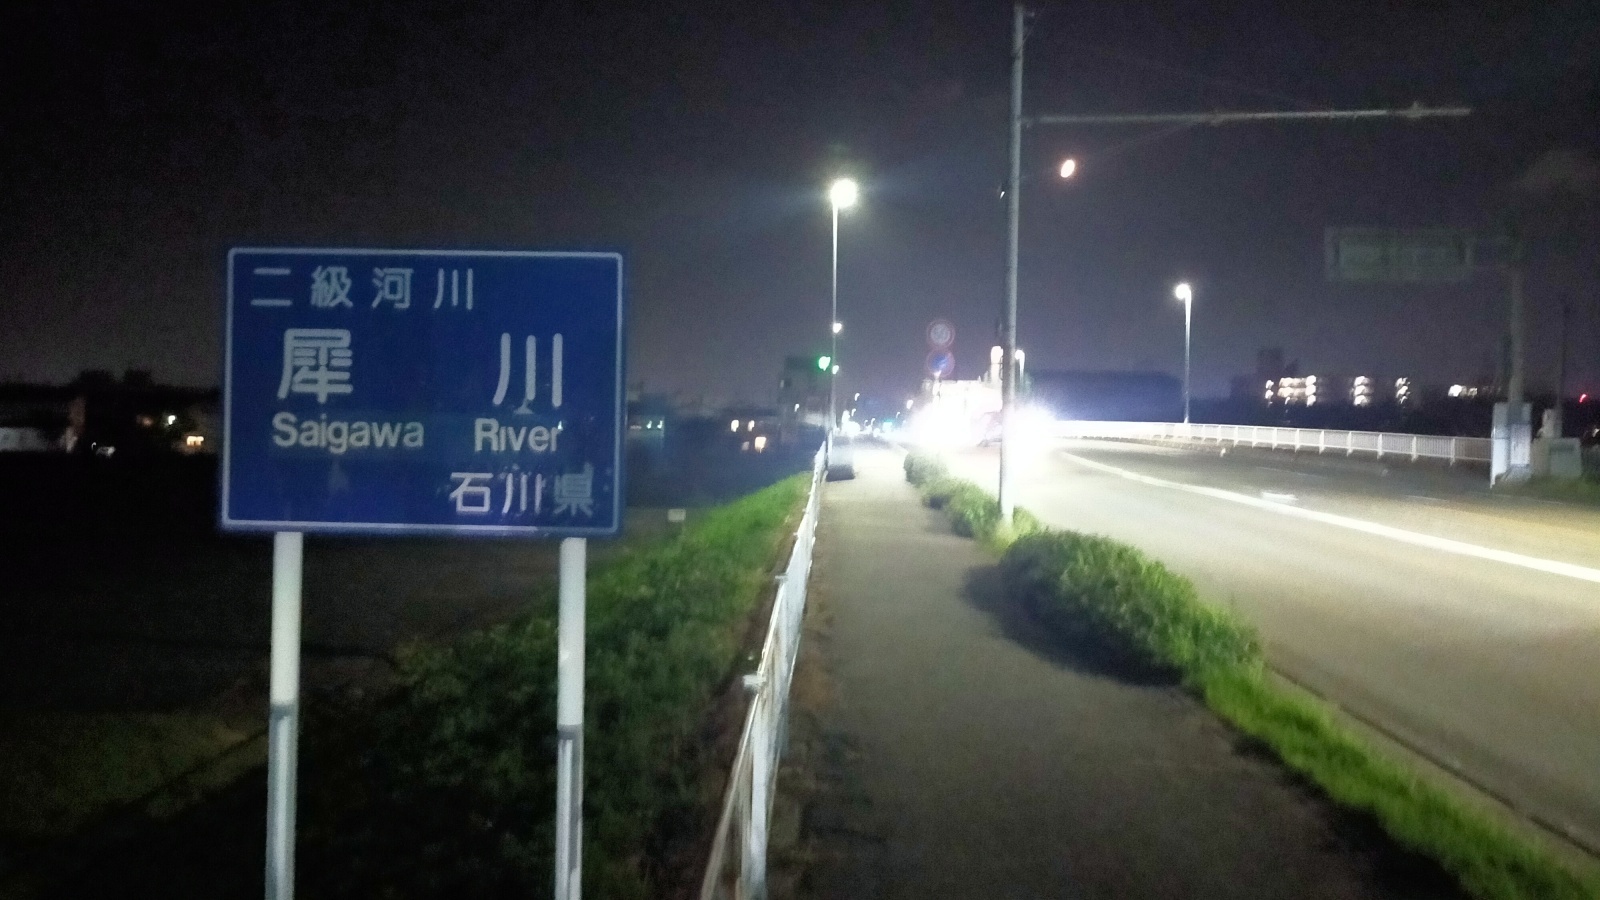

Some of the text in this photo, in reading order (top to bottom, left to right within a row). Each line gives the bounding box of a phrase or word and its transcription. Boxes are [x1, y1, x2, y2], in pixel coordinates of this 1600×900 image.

[250, 265, 474, 310] 二級河川
[272, 413, 562, 454] Saigawa River
[449, 465, 594, 516] 石川県
